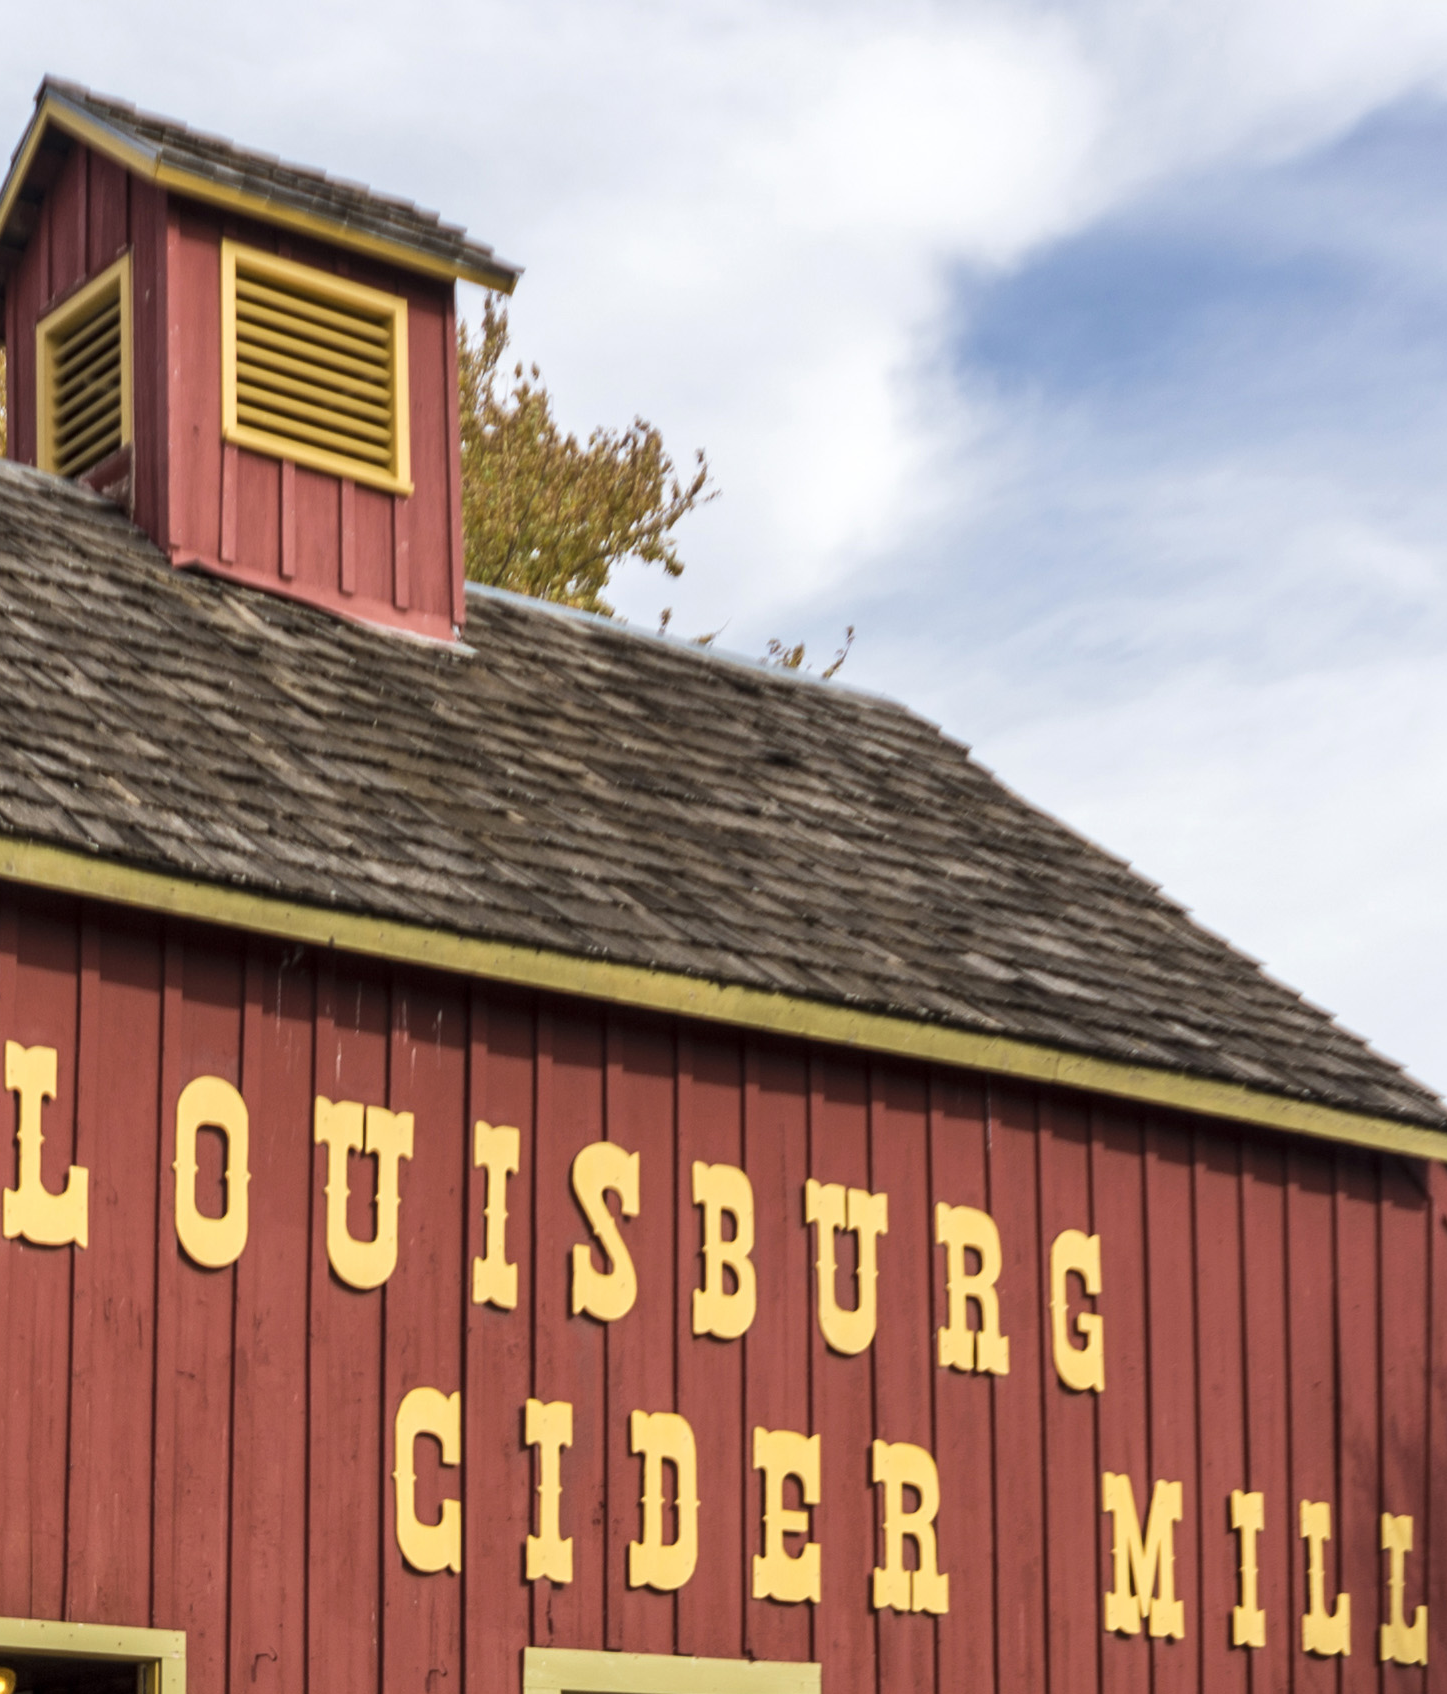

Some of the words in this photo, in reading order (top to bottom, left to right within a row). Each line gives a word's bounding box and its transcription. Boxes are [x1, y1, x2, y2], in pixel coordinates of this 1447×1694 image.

[3, 1039, 1105, 1393] LOUISBURG
[392, 1386, 950, 1614] CIDER
[1102, 1471, 1428, 1666] MILL
